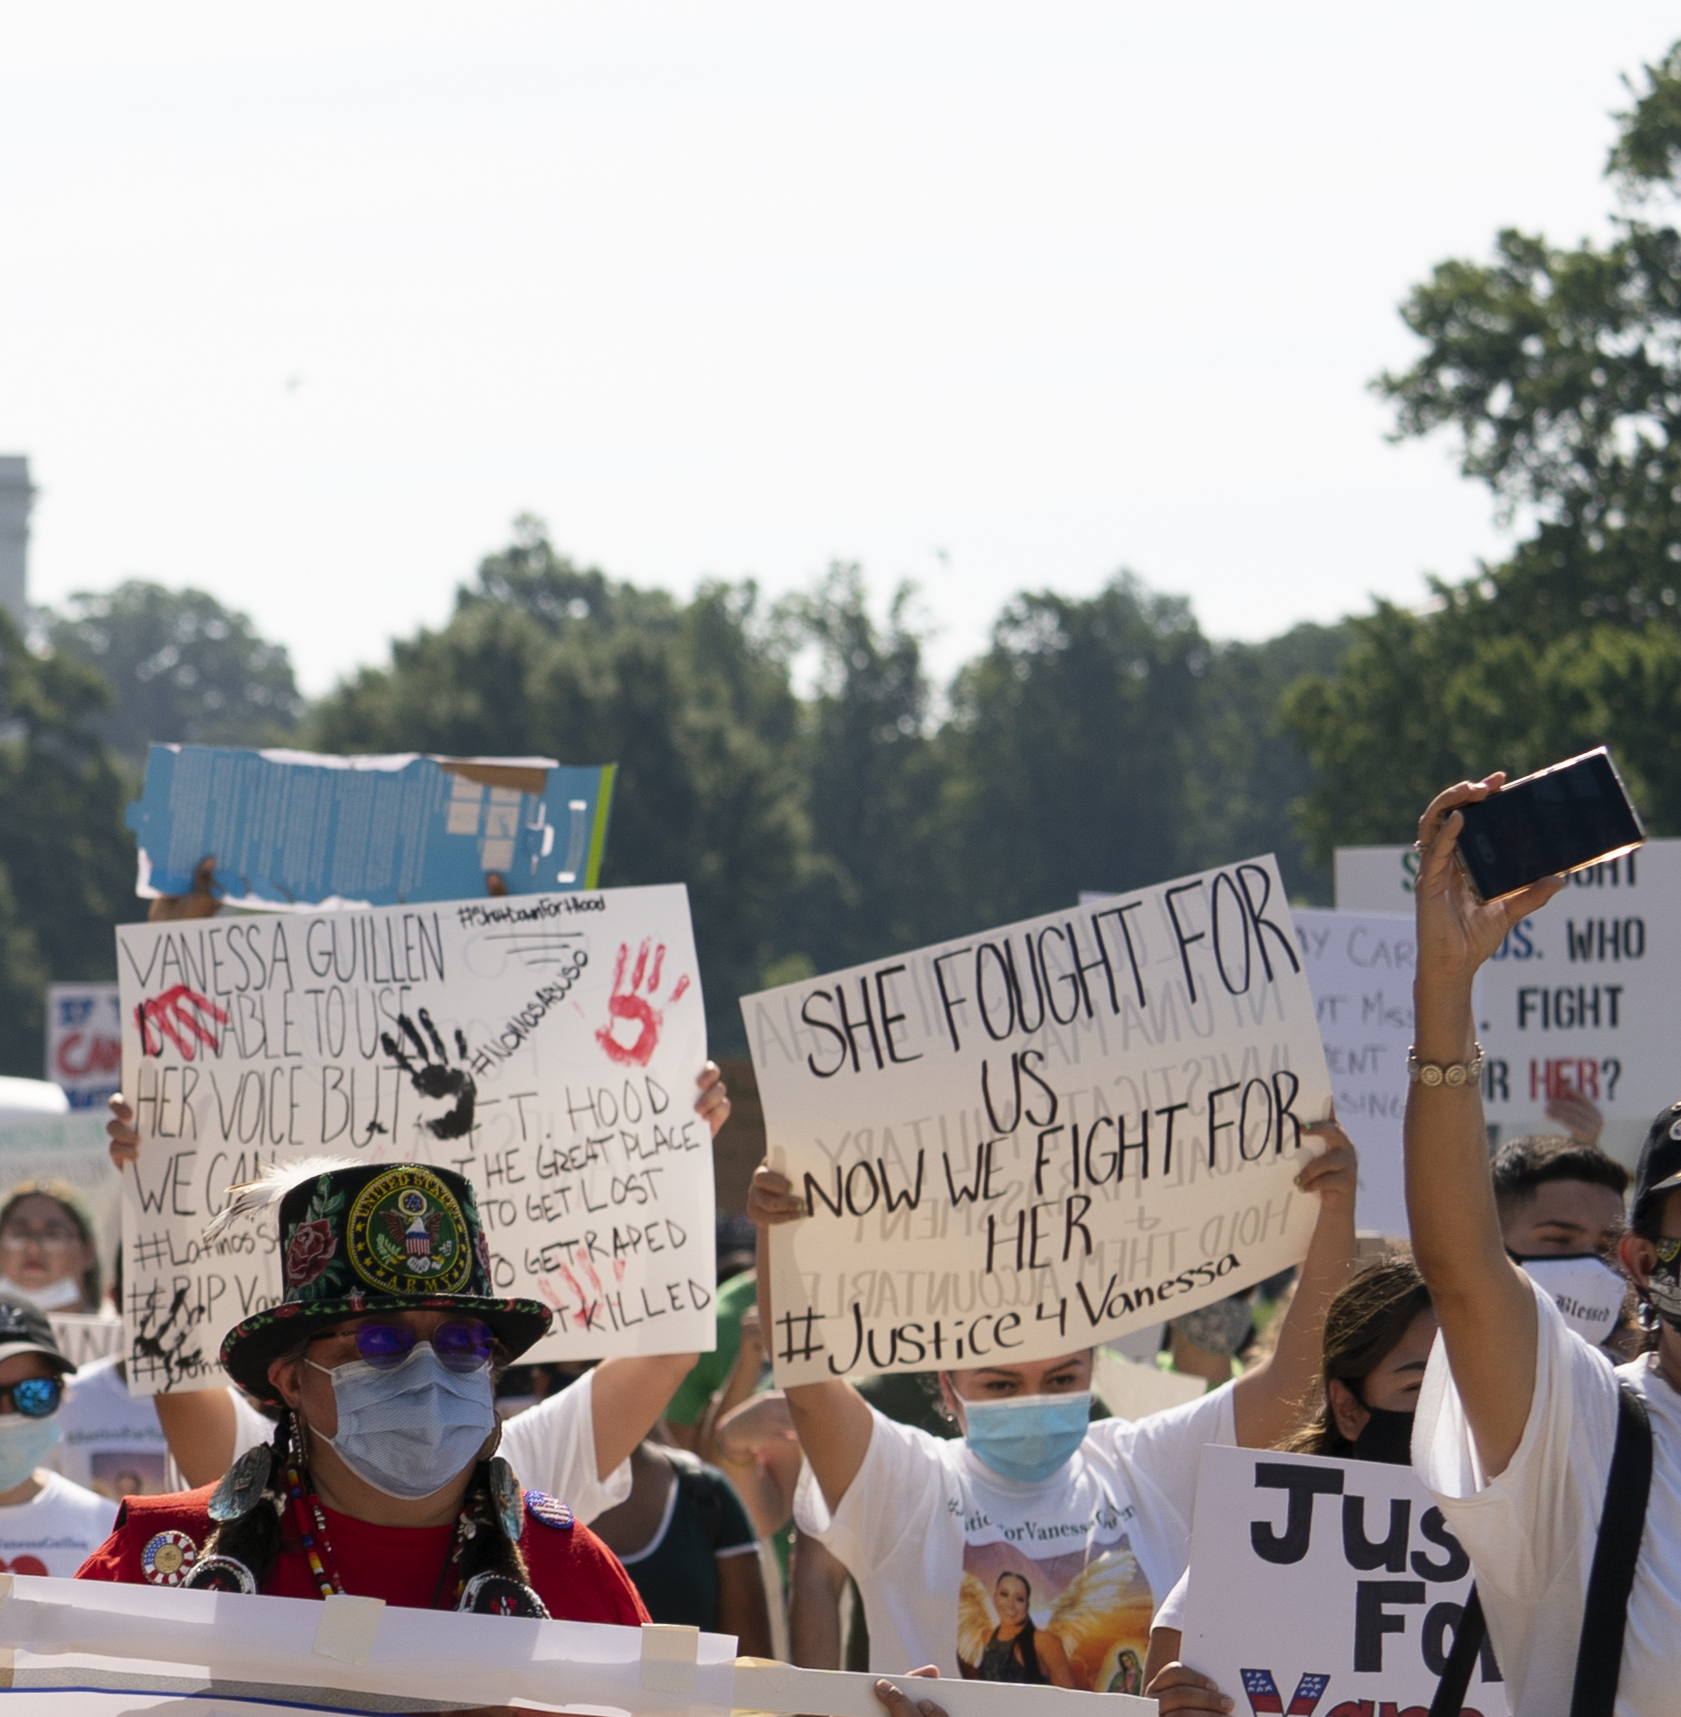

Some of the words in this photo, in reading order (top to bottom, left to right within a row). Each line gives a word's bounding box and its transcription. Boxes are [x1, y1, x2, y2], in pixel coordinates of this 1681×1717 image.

[120, 921, 294, 997] VANESSA
[306, 911, 445, 983] GUILLEN
[799, 963, 924, 1079] SHE
[933, 900, 1146, 1053] FOUGHT
[1164, 863, 1302, 1005] FOR
[1346, 923, 1415, 970] CAR
[1566, 917, 1646, 962] WHO
[304, 984, 346, 1059] TO
[1517, 985, 1624, 1031] FIGHT
[137, 1066, 200, 1141] HER
[210, 1065, 304, 1146] VOICE
[321, 1064, 404, 1148] BUT
[565, 1075, 670, 1134] HOOD
[980, 1049, 1059, 1135] US
[451, 1148, 526, 1189] THE
[536, 1133, 615, 1180] GREAT
[619, 1120, 701, 1162] PLACE
[803, 1148, 925, 1219] NOW
[942, 1135, 1009, 1207] WE
[1033, 1102, 1190, 1196] FIGHT
[1206, 1069, 1303, 1169] FOR
[133, 1151, 198, 1217] WE
[356, 1173, 410, 1218] UNITED
[413, 1173, 461, 1219] STATES
[478, 1198, 518, 1231] TO
[525, 1186, 572, 1223] GET
[581, 1167, 664, 1213] LOST
[524, 1238, 580, 1275] GET
[583, 1218, 688, 1264] RAPED
[985, 1193, 1094, 1275] HER
[234, 1273, 283, 1317] Van
[387, 1274, 455, 1292] ARMY
[582, 1278, 712, 1333] KILLED
[774, 1302, 1025, 1377] #Justice
[1035, 1296, 1068, 1338] 4
[1074, 1252, 1243, 1328] Vanessa
[1250, 1462, 1472, 1583] Jus
